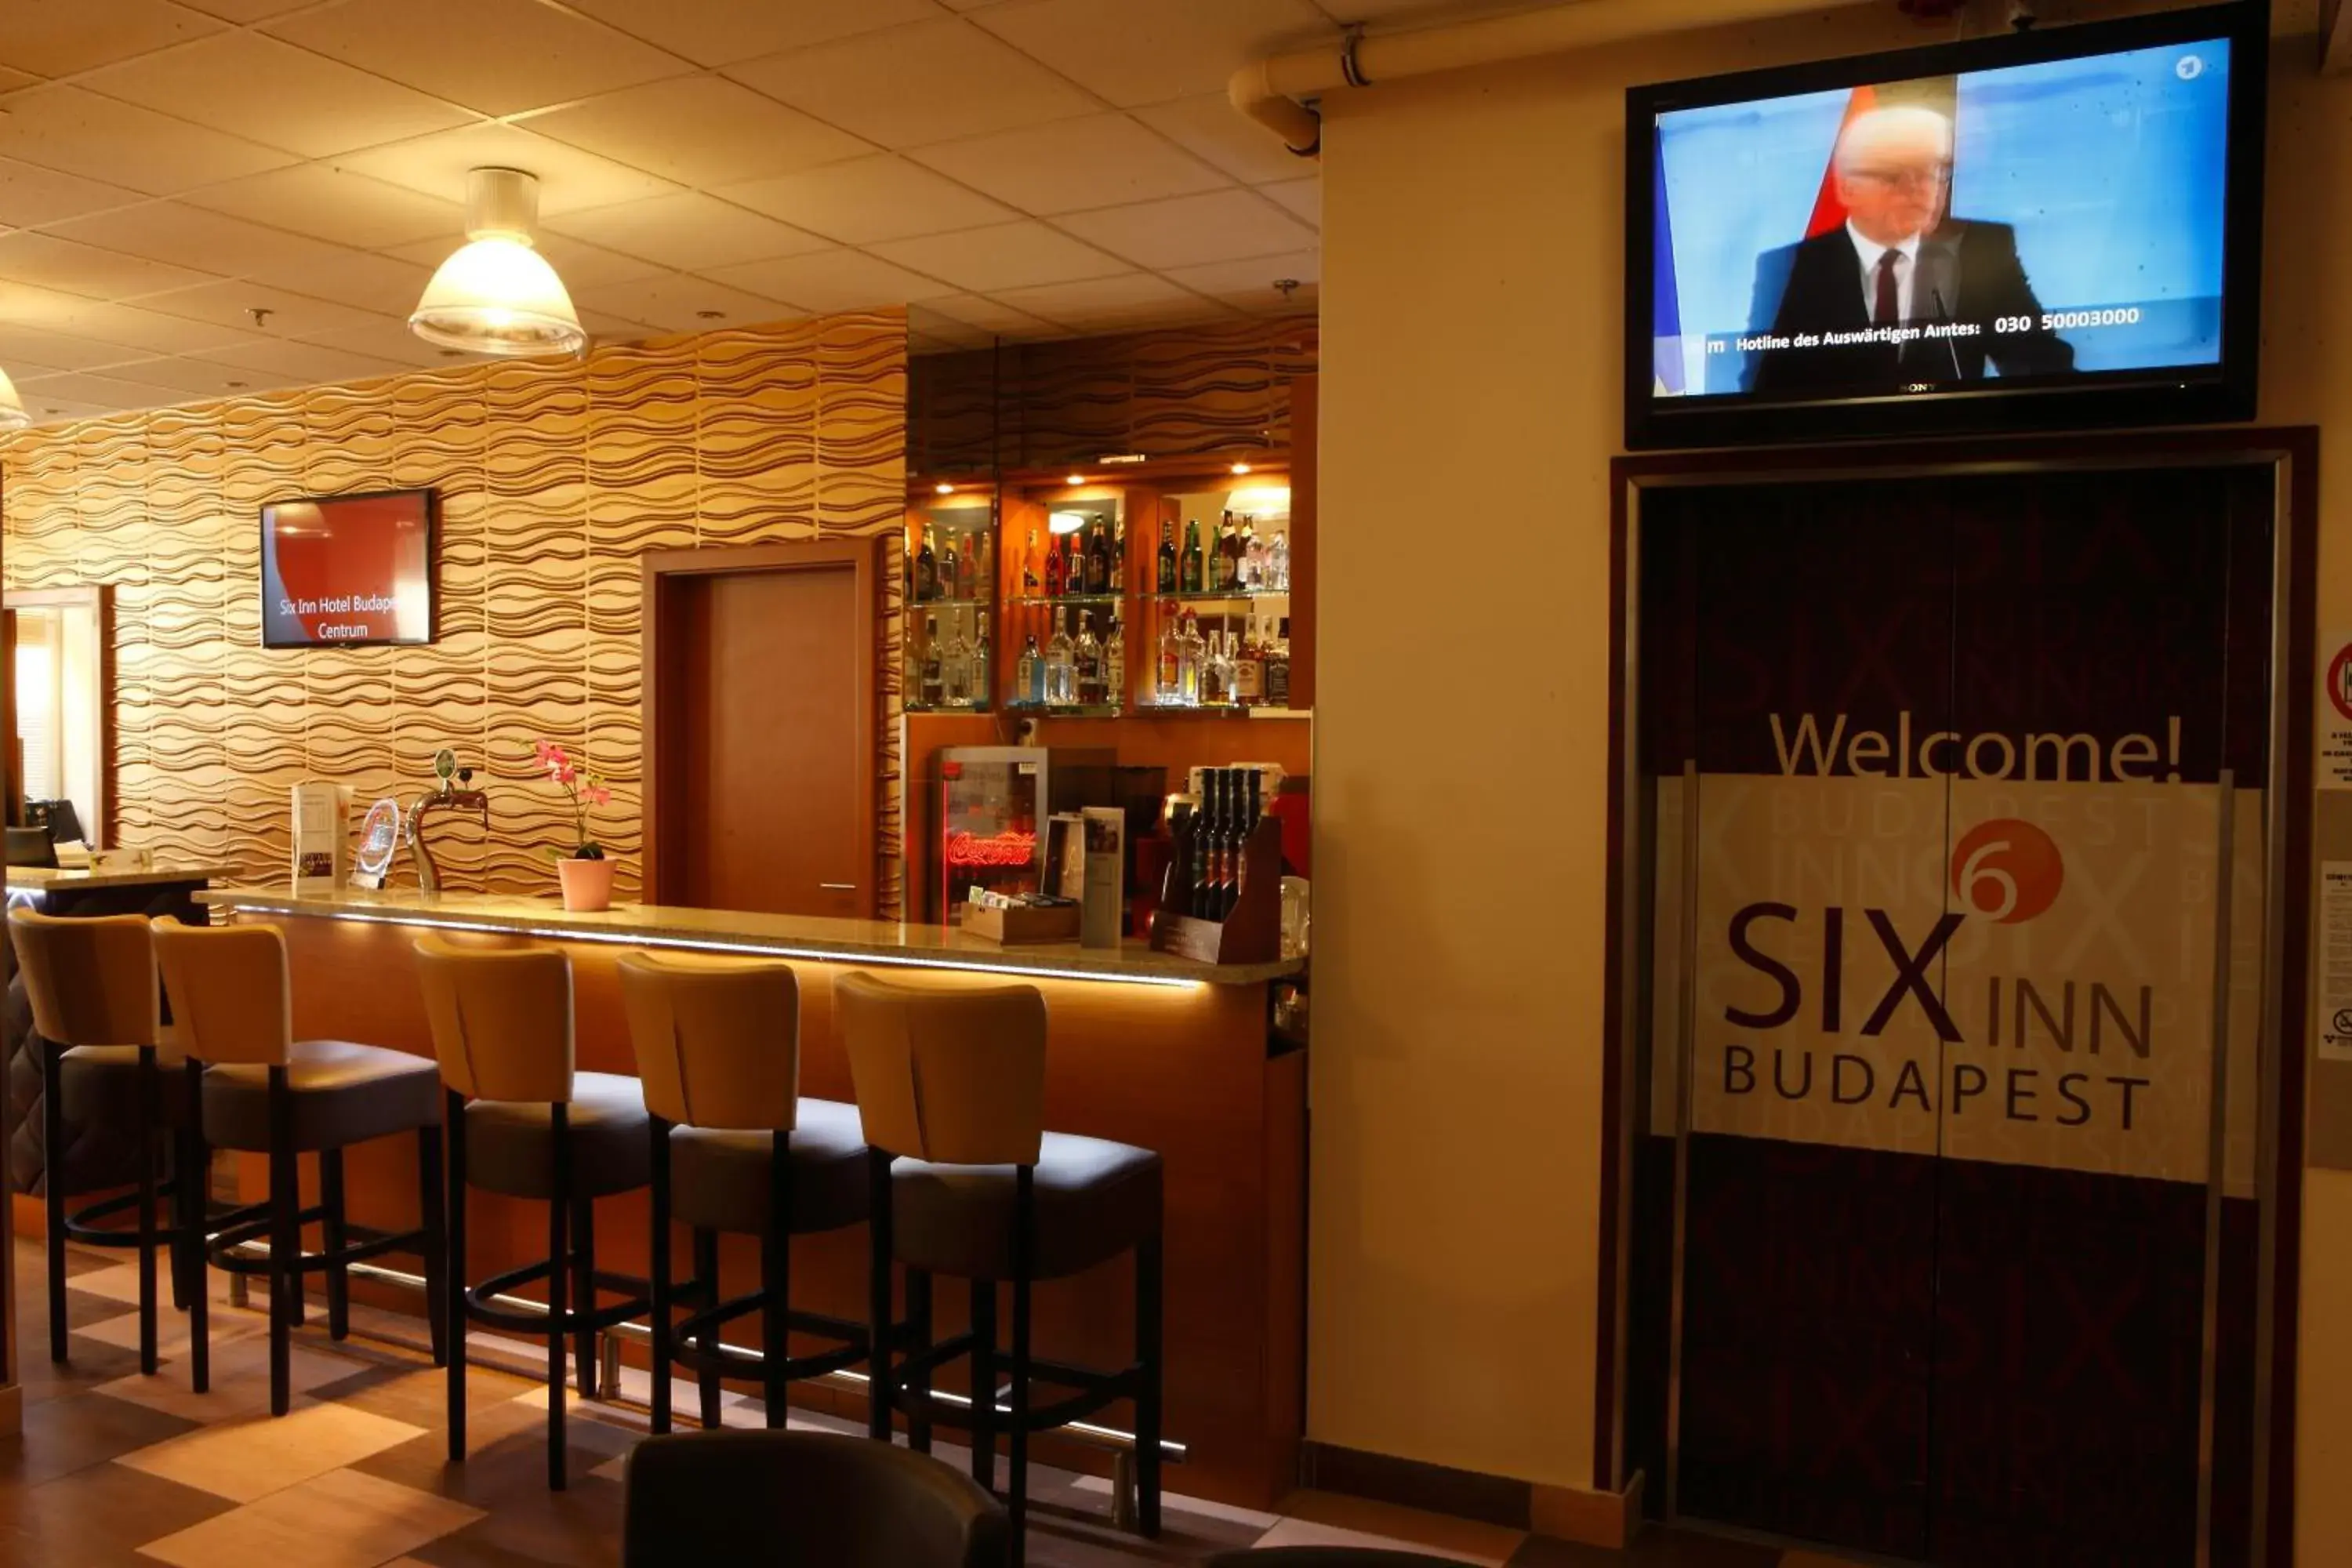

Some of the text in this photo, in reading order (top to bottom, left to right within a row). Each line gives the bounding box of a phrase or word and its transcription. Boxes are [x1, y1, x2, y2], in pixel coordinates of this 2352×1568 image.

[1736, 335, 1790, 353] Hotline
[1793, 332, 1820, 348] des
[1823, 325, 1921, 347] Auswärtigen
[1994, 315, 2031, 334] 030
[2041, 307, 2140, 331] 50003000
[279, 599, 296, 615] Six
[298, 597, 317, 614] Inn
[319, 595, 350, 612] Hotel
[318, 622, 368, 639] Centrum
[1769, 710, 2181, 783] Welcome!
[1725, 901, 2154, 1059] SIX INN
[1723, 1044, 2151, 1131] BUDAPEST
